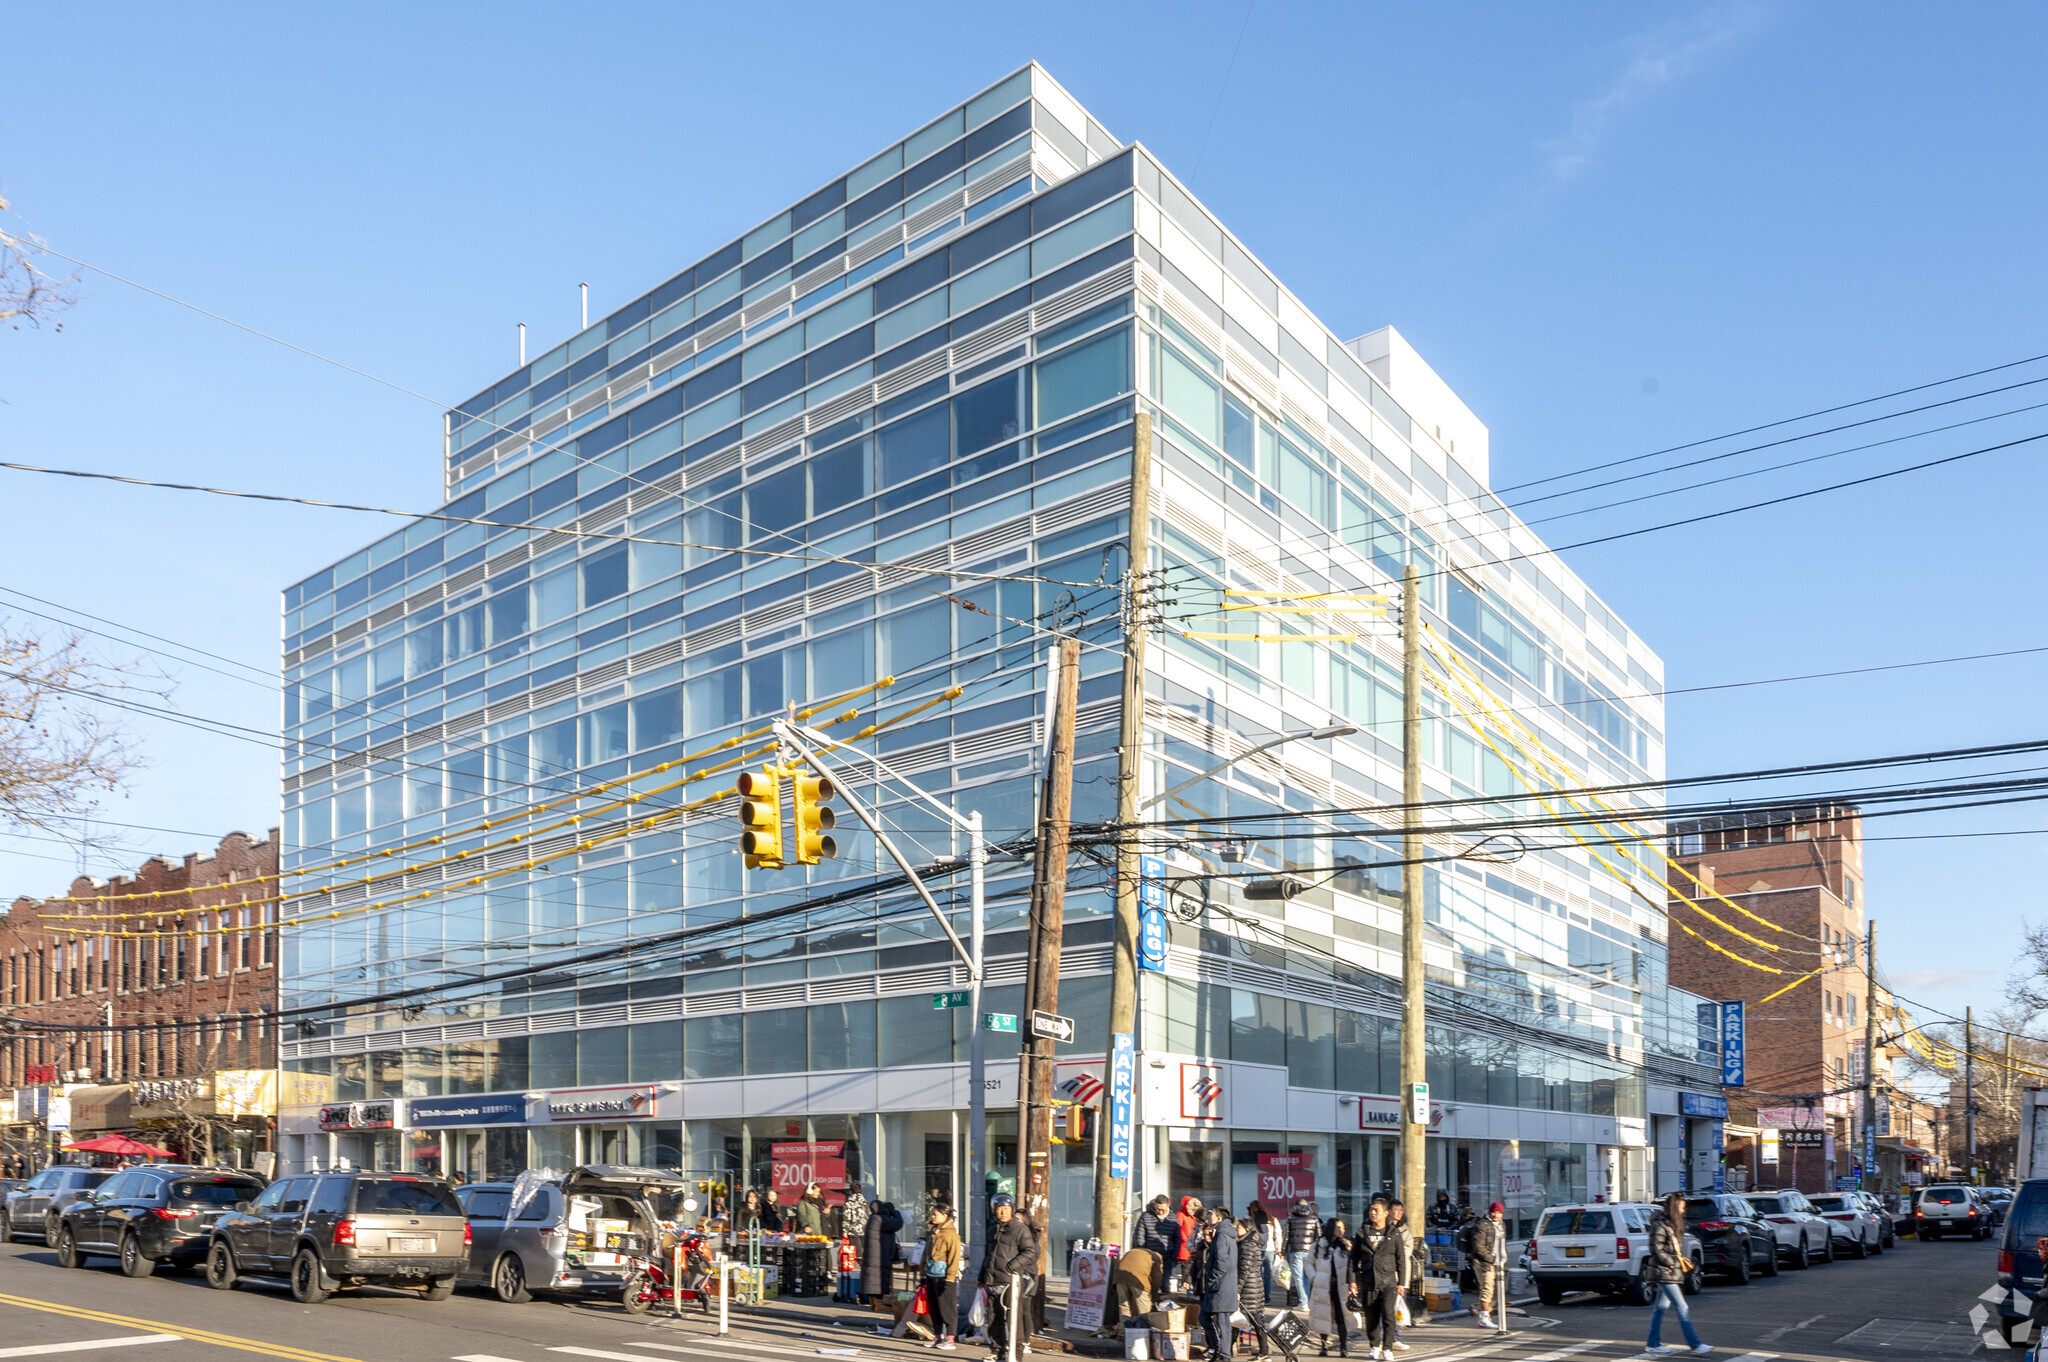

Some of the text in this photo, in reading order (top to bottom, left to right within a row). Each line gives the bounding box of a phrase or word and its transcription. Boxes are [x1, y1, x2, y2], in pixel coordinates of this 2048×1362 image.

[941, 992, 963, 1007] 8 AV
[987, 1015, 1012, 1029] 56 ST
[1036, 1018, 1048, 1030] ONE
[1724, 1004, 1742, 1068] PARKING
[1113, 1036, 1131, 1157] PARKING
[1368, 1111, 1389, 1121] BANK
[809, 1145, 838, 1153] CUSTOMERS
[1865, 1126, 1874, 1171] PARKING
[774, 1163, 813, 1186] $200
[813, 1176, 843, 1184] CASH OFFER
[1262, 1176, 1295, 1200] $200
[1504, 1175, 1522, 1193] $200
